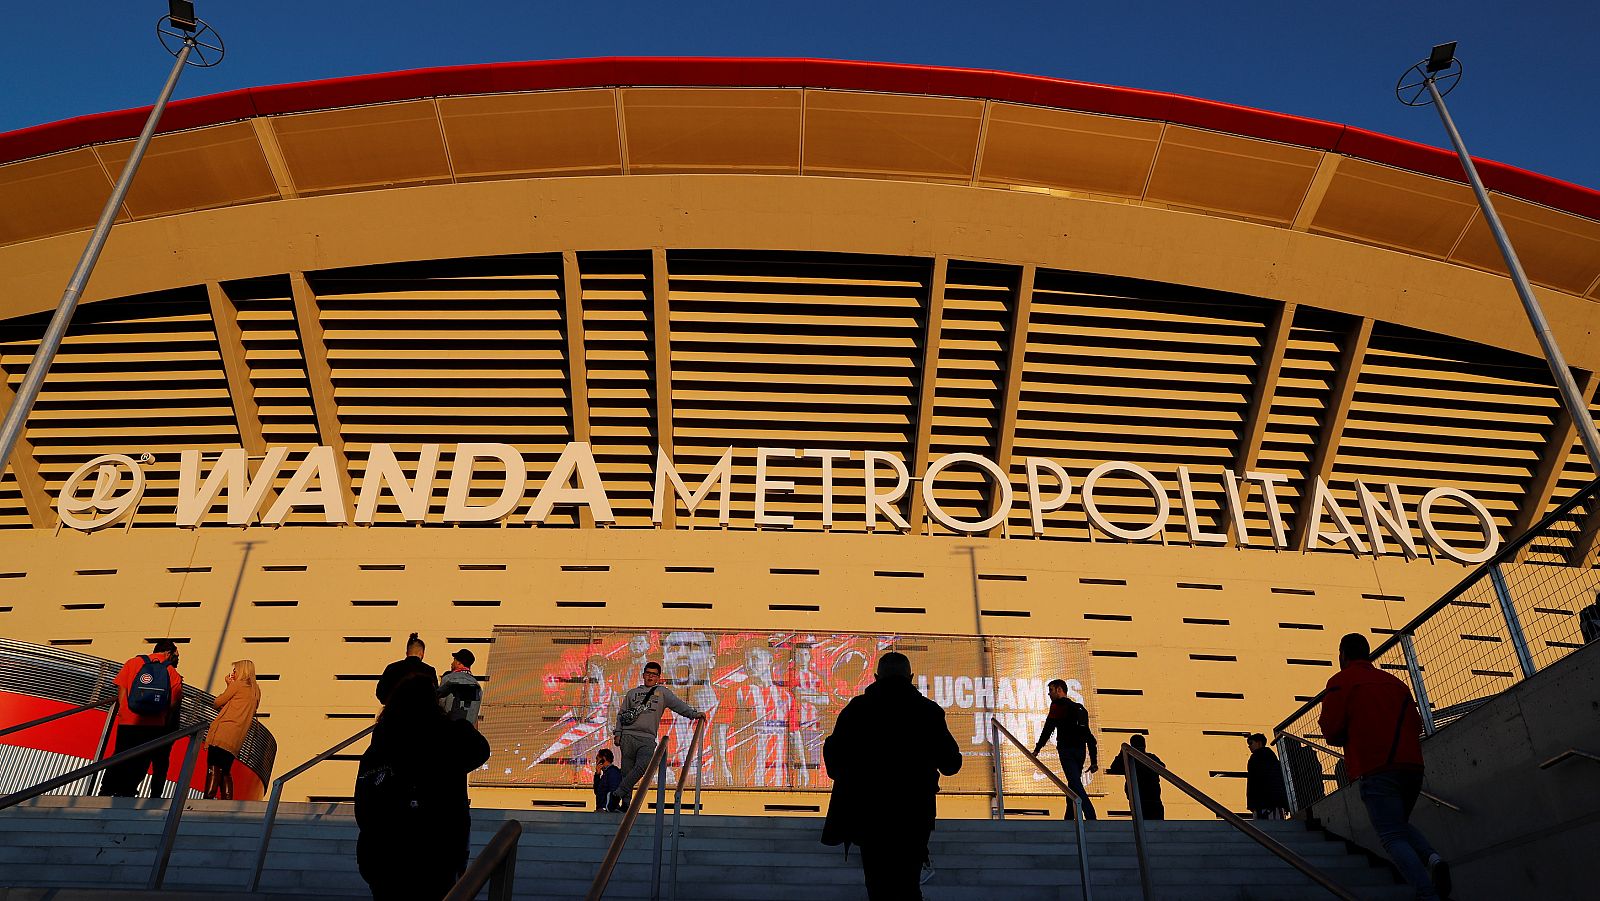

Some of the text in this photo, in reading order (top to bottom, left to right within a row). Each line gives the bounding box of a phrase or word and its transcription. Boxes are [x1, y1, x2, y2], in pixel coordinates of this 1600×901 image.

[176, 442, 1500, 564] WANDA METROPOLITANO
[917, 674, 1084, 709] UCHAMS
[972, 711, 1058, 746] JUNT
